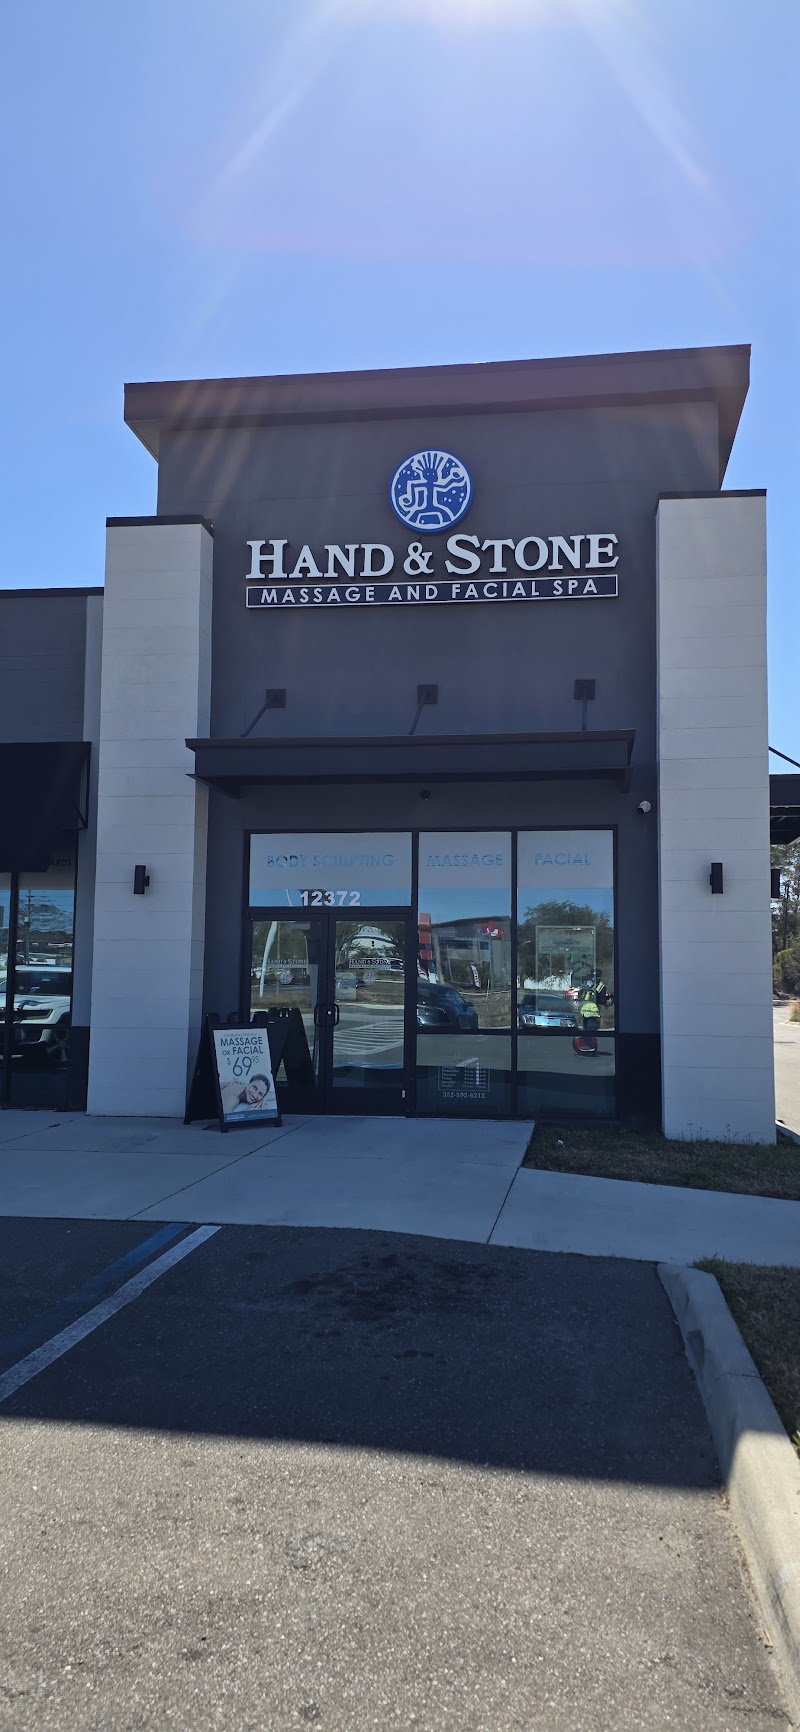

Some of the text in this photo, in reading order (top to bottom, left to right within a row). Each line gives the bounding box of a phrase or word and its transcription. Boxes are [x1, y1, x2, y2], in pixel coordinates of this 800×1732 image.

[246, 533, 619, 579] HAND & STONE
[260, 578, 598, 604] MASSAGE AND FACIAL SPA
[266, 854, 394, 867] BODY SCULPTING
[426, 854, 503, 867] MASSAGE
[534, 852, 591, 866] FACIAL
[300, 890, 361, 907] 12372
[220, 1037, 263, 1047] MASSAGE
[232, 1046, 263, 1055] FACIAL
